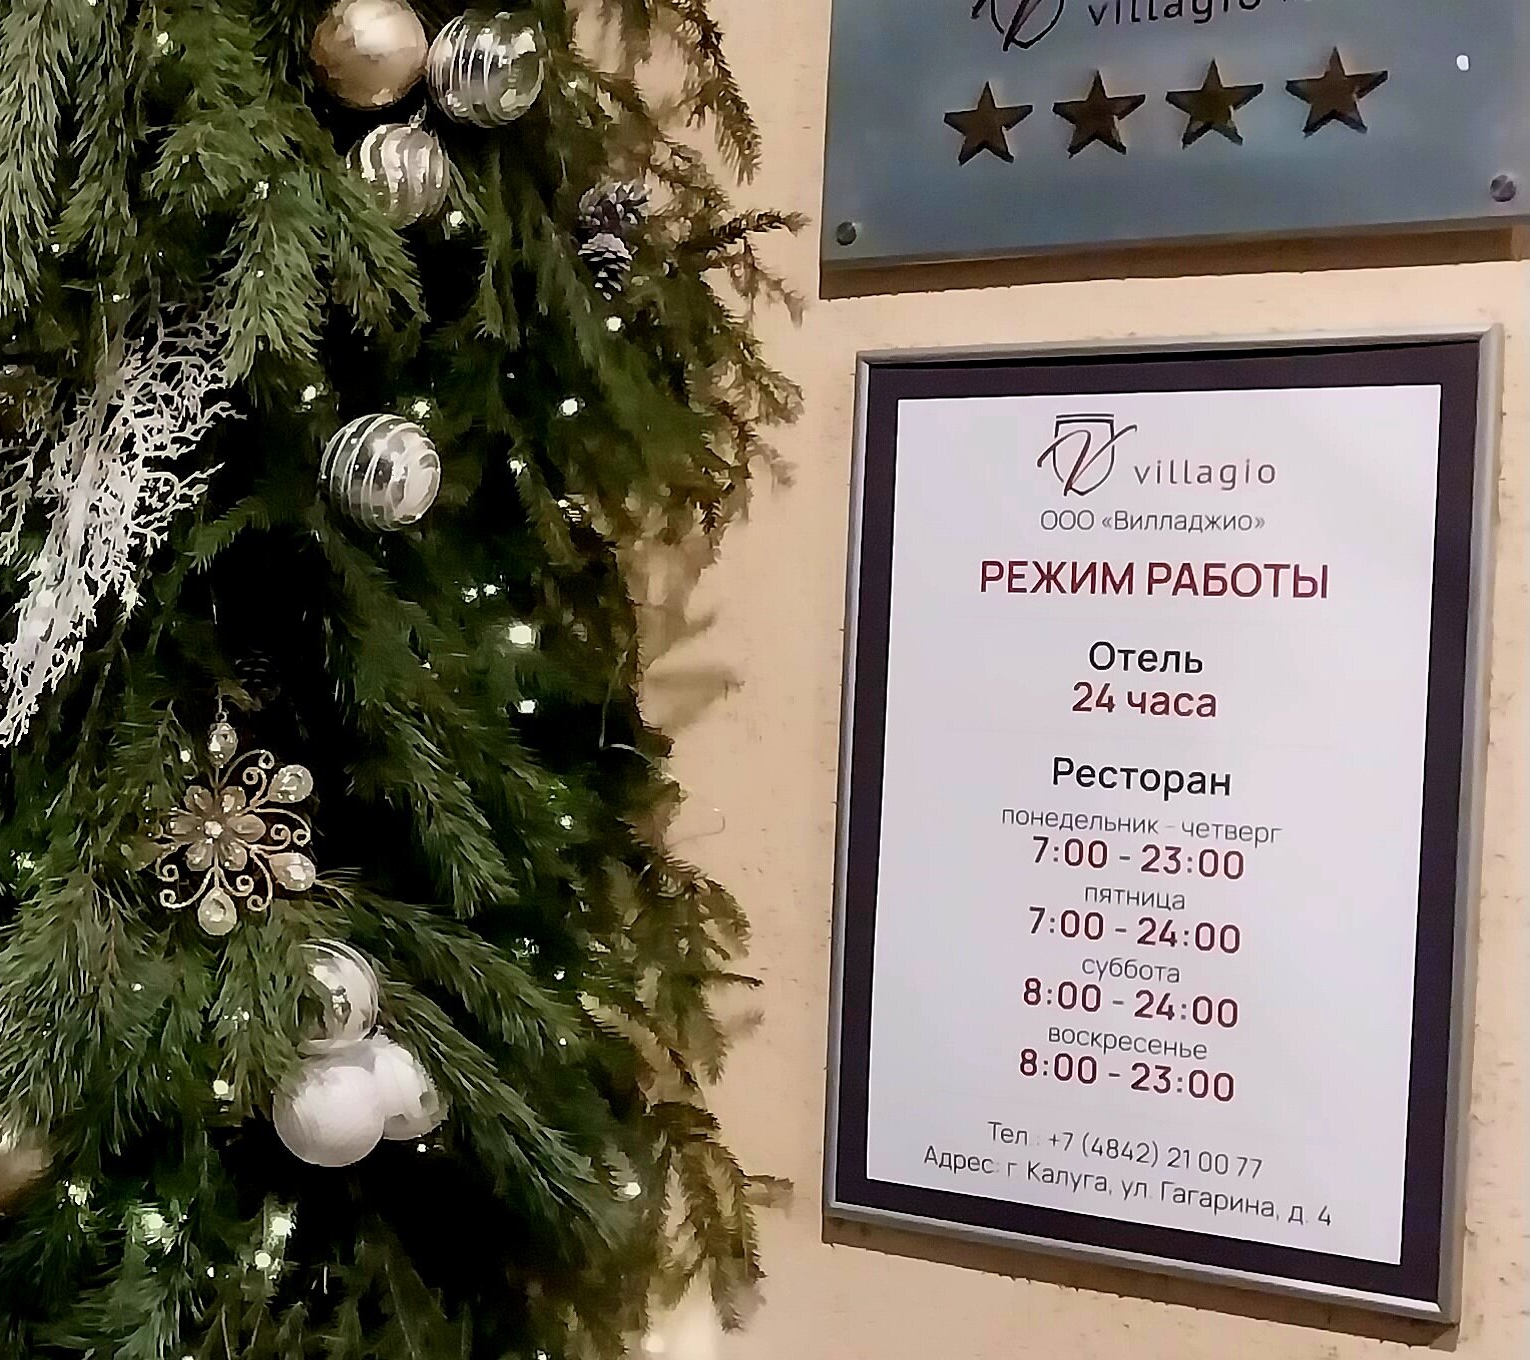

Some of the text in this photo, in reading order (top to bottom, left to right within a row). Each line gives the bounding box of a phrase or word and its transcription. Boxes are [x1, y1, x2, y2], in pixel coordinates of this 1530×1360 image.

[1133, 459, 1276, 491] villagio
[1040, 510, 1266, 534] ООО «Вилладжио»
[980, 561, 1329, 598] РЕЖИМ РАБОТЫ
[1088, 642, 1203, 675] Отель
[1072, 681, 1217, 718] 24 часа
[1052, 757, 1231, 801] Ресторан
[1002, 807, 1159, 838] понедельник
[1181, 822, 1282, 846] четверг
[1032, 835, 1108, 869] 7:00
[1140, 844, 1245, 881] 23:00
[1084, 886, 1186, 911] пятница
[1028, 907, 1104, 941] 7:00
[1136, 916, 1241, 954] 24:00
[1081, 956, 1181, 984] суббота
[1023, 978, 1102, 1013] 8:00
[1133, 989, 1239, 1028] 24:00
[1048, 1025, 1208, 1061] воскресенье
[1019, 1048, 1098, 1084] 8:00
[1130, 1062, 1235, 1103] 23:00
[1048, 1130, 1074, 1154] +7
[1081, 1132, 1160, 1169] (4842)
[1167, 1146, 1192, 1170] 21
[1198, 1150, 1230, 1175] 00
[1236, 1155, 1262, 1180] 77
[1028, 1161, 1113, 1198] Калуга,
[1160, 1182, 1280, 1222] Гагарина,
[1288, 1203, 1310, 1226] д.
[1317, 1205, 1333, 1227] 4
